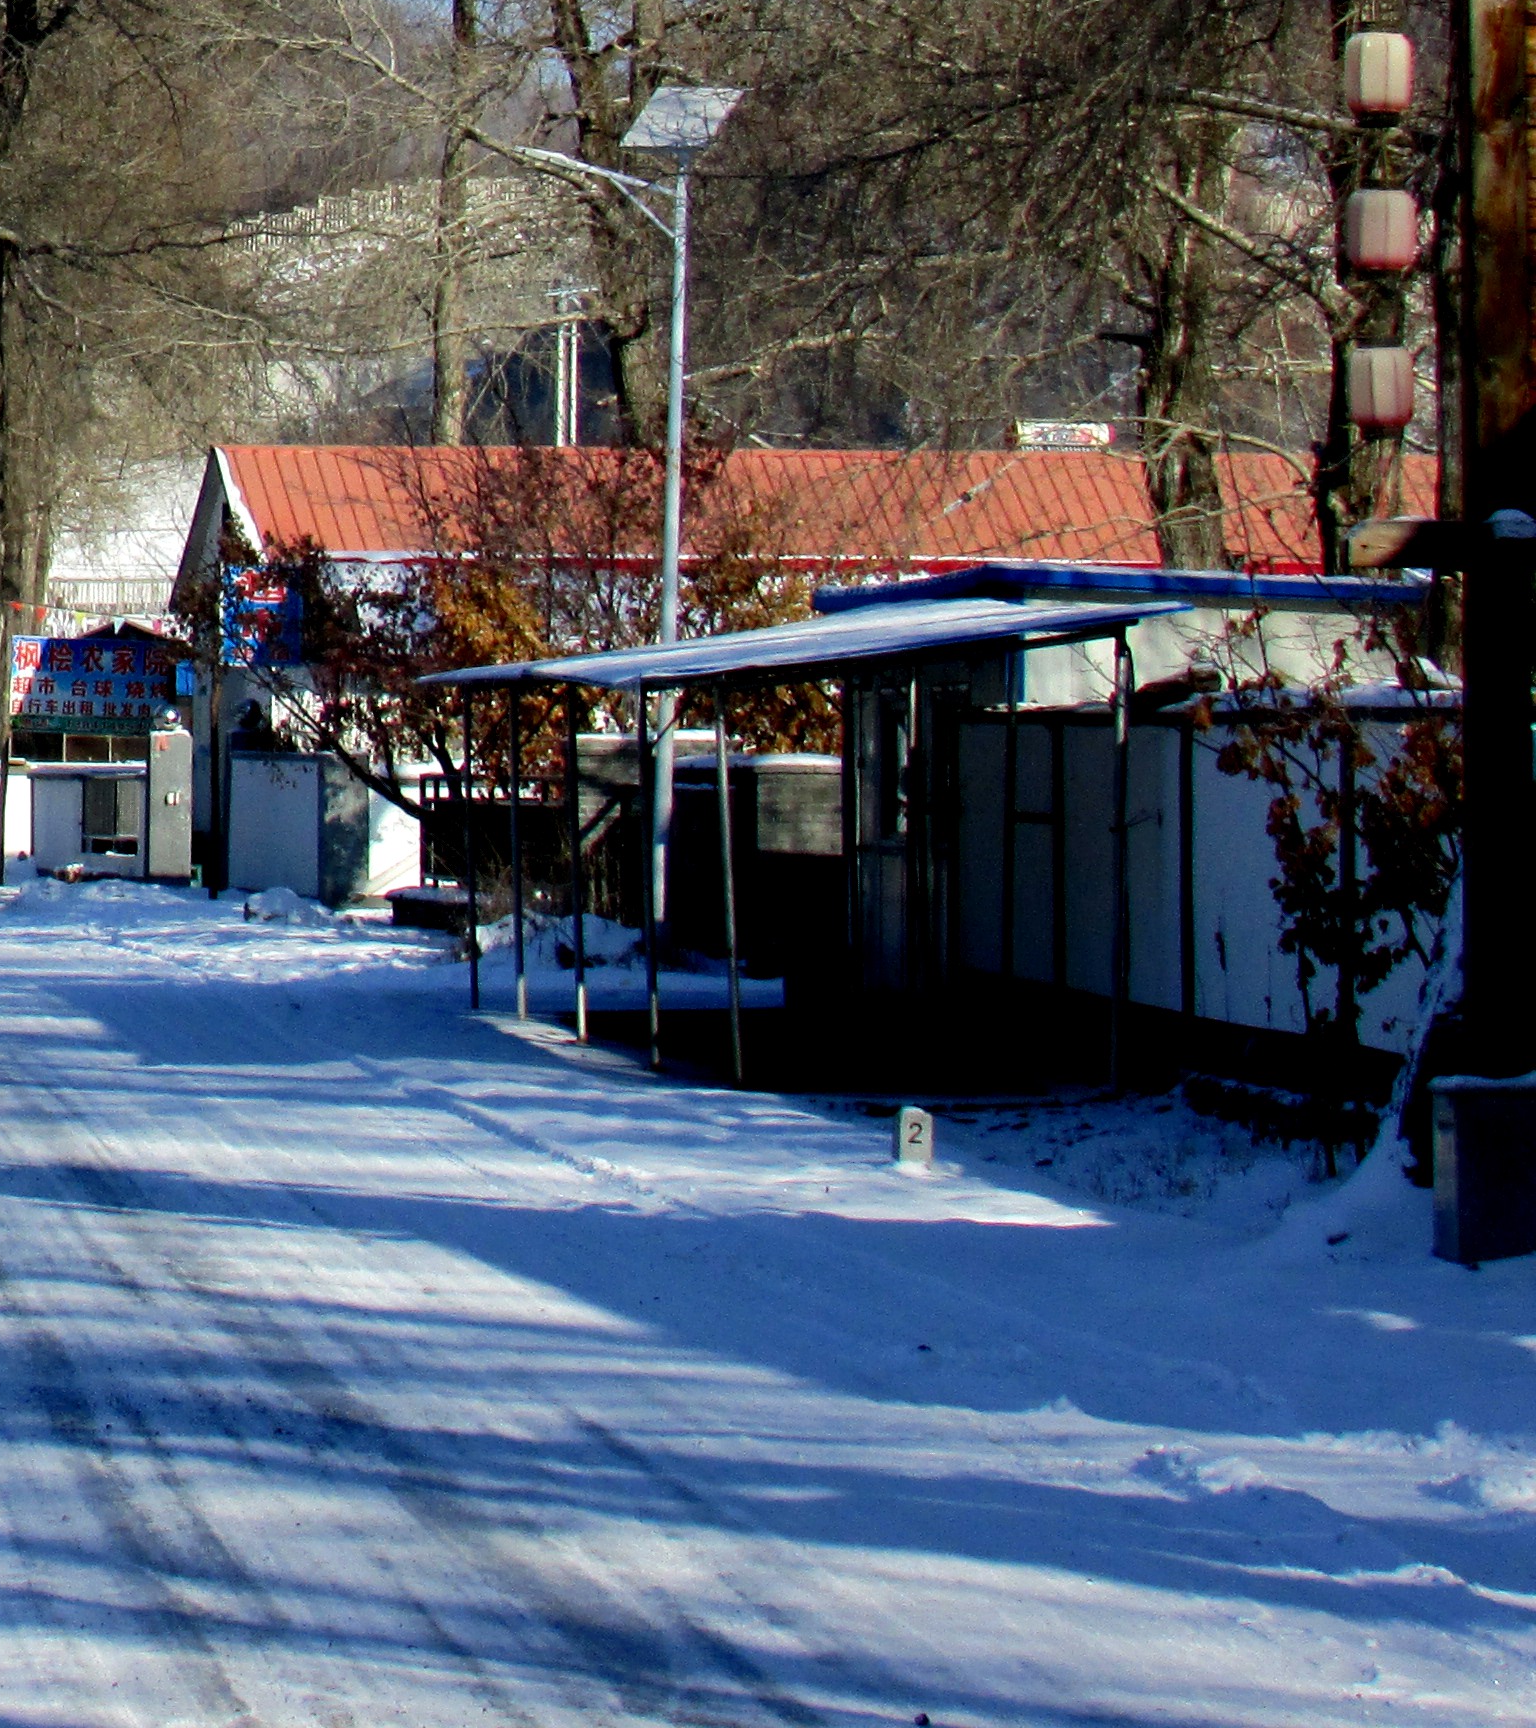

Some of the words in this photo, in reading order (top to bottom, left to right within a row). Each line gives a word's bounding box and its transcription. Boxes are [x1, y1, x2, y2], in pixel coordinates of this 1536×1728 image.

[12, 676, 56, 695] 超市
[71, 679, 114, 697] 台球
[12, 699, 94, 715] 自行车出租
[908, 1122, 923, 1144] 2
